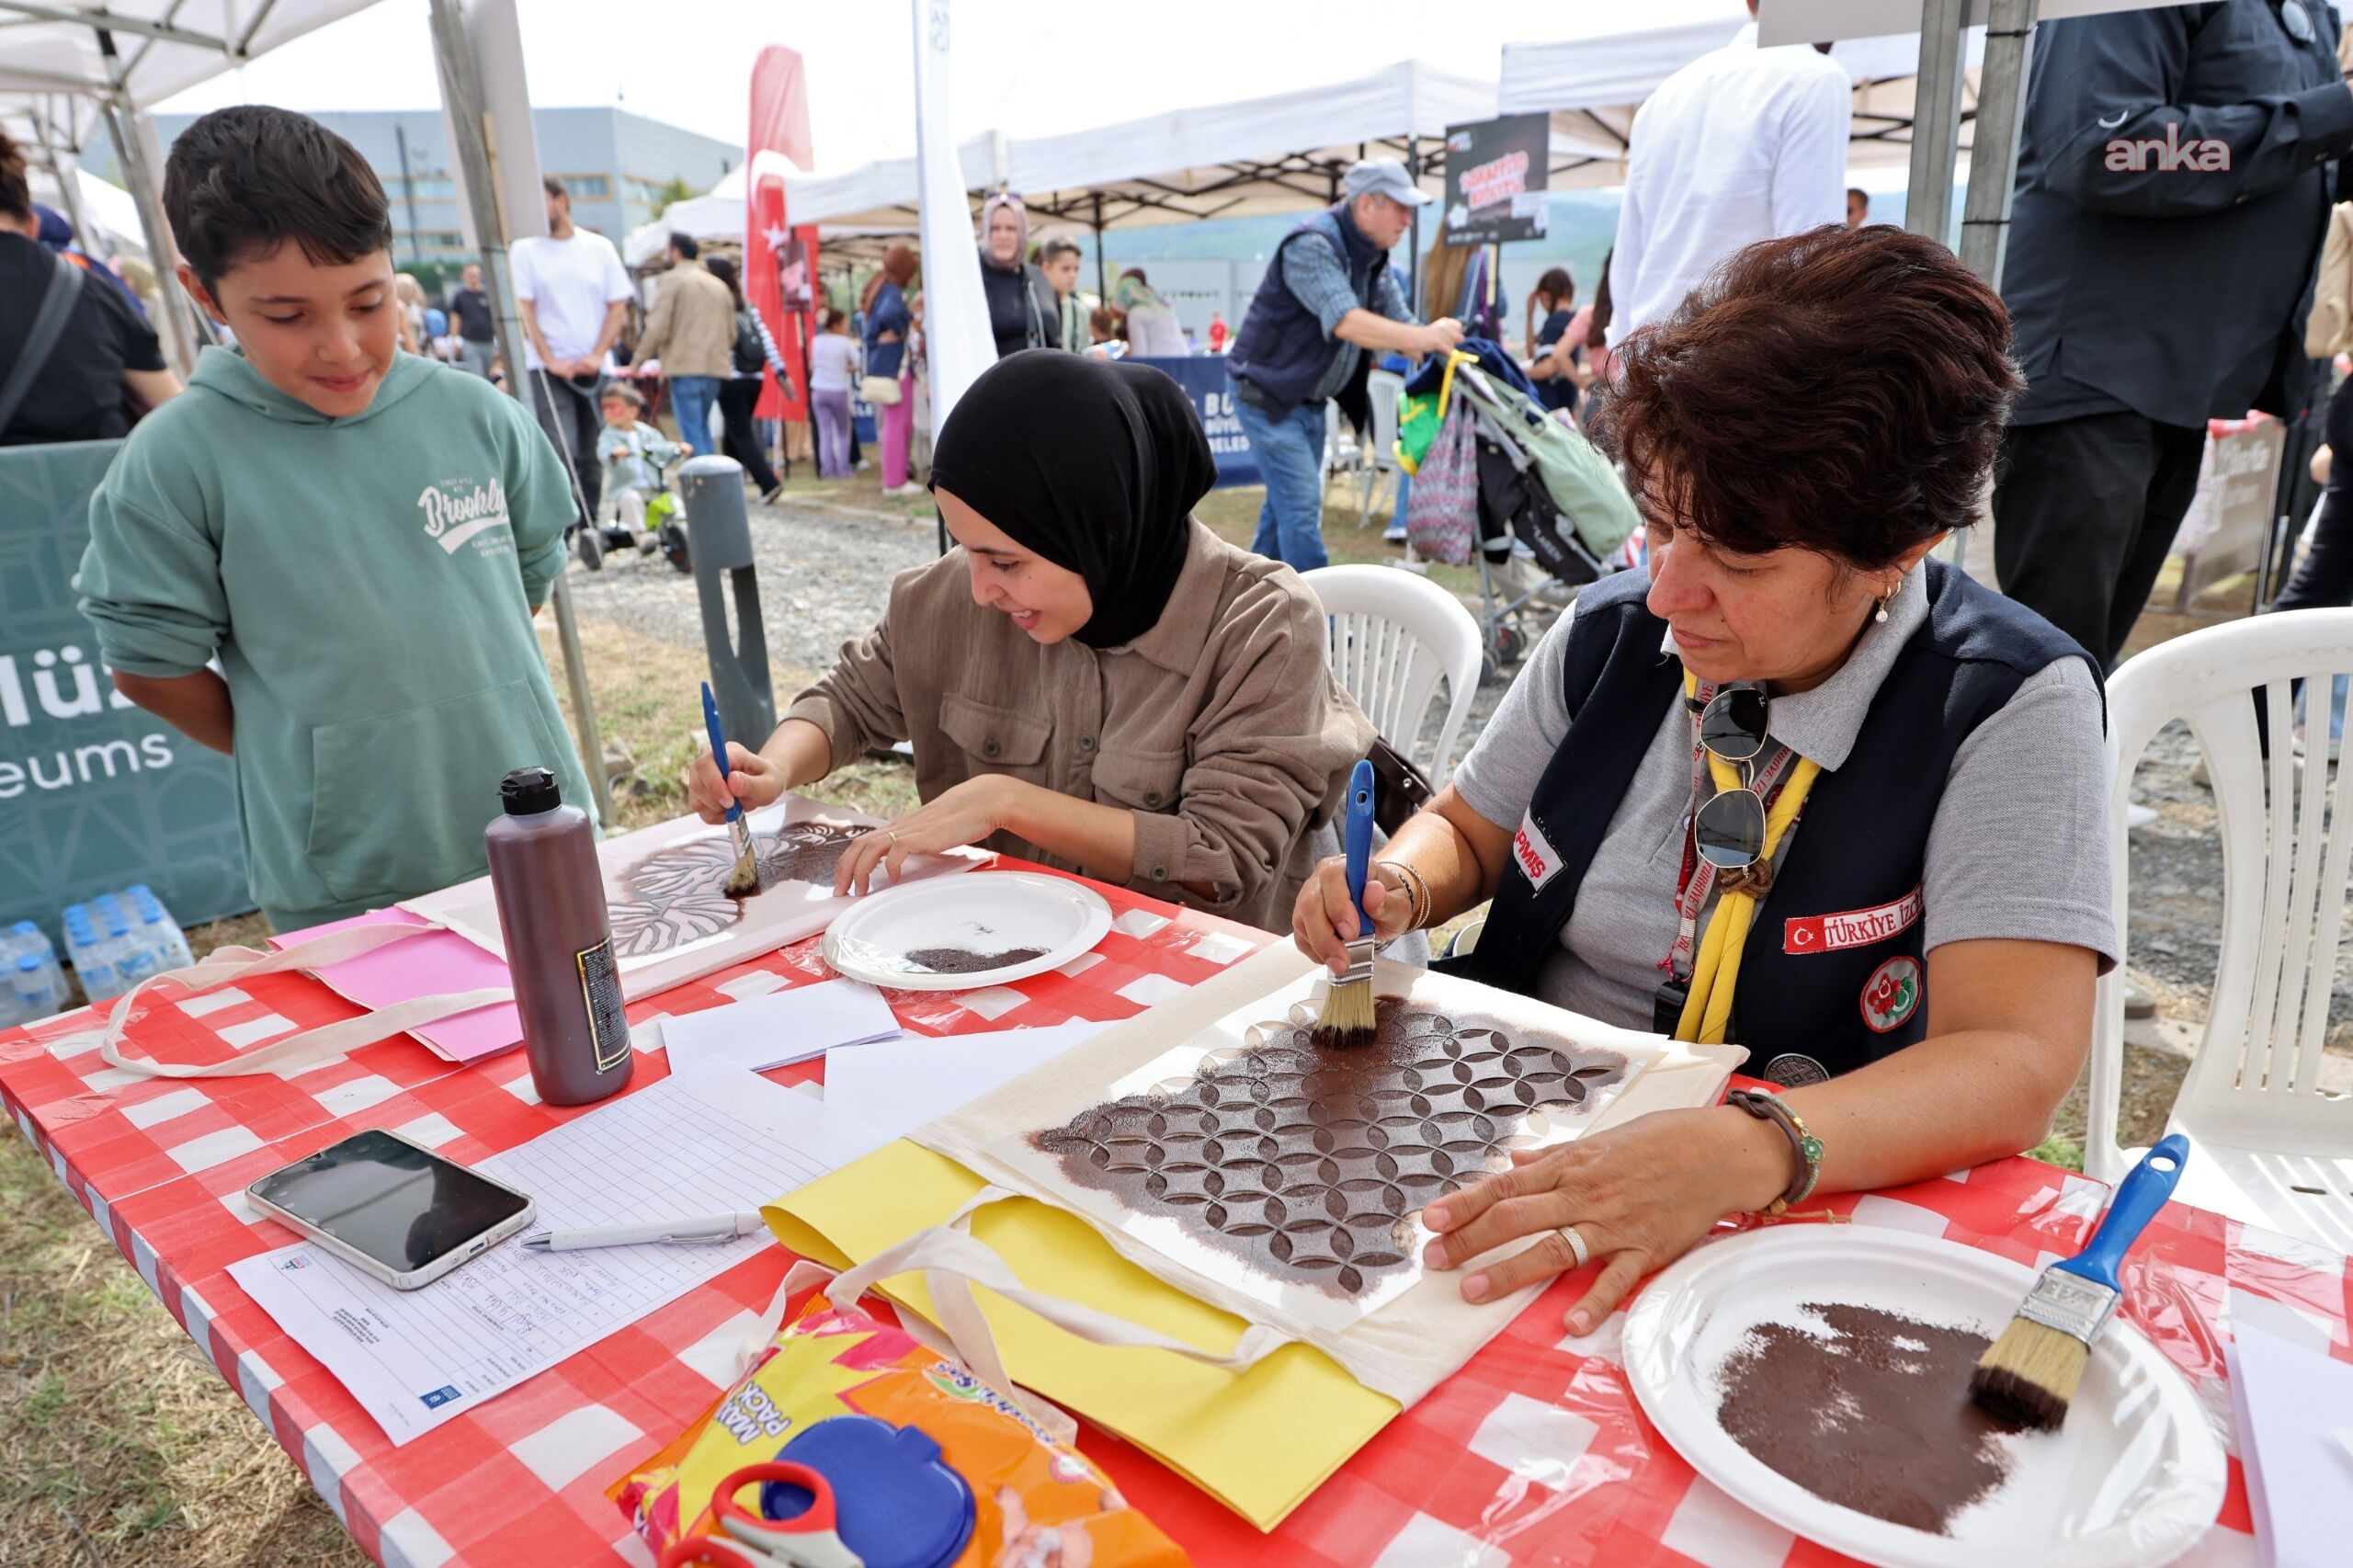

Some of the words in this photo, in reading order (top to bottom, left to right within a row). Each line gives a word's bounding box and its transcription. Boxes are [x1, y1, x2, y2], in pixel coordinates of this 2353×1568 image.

[0, 733, 174, 798] eums
[1824, 914, 1897, 946] TÜRKİYE
[734, 1381, 792, 1438] PACK
